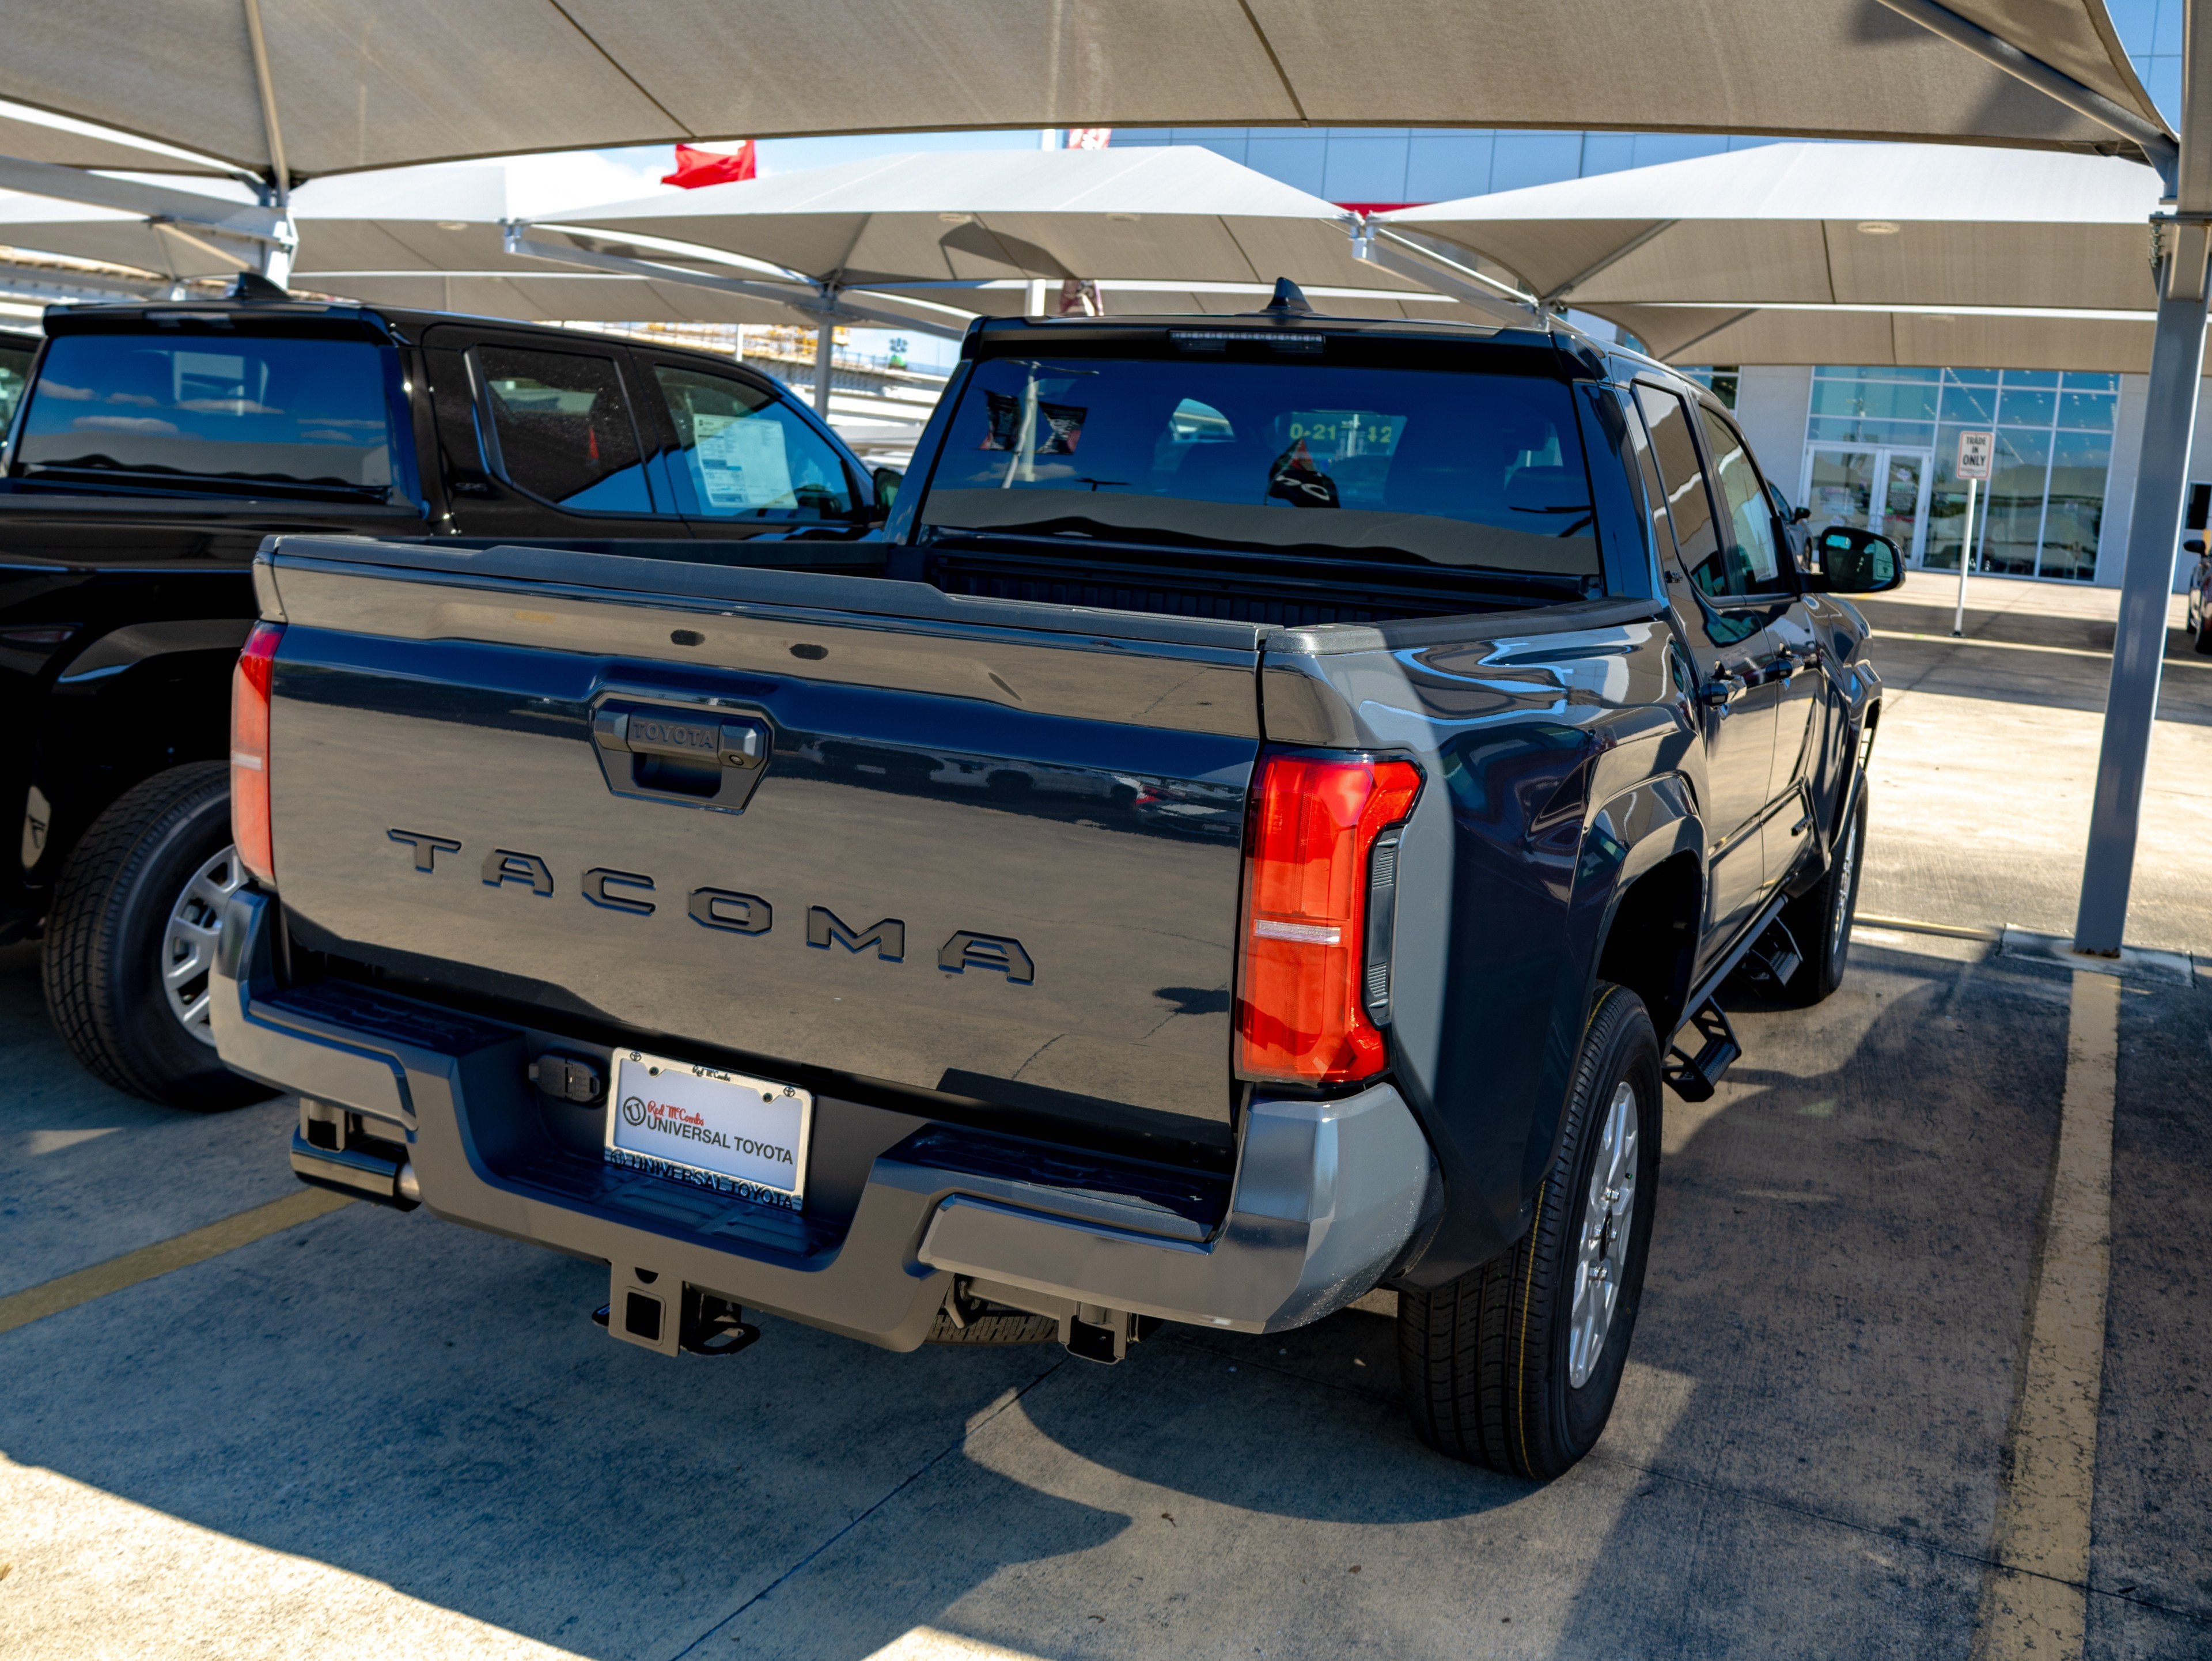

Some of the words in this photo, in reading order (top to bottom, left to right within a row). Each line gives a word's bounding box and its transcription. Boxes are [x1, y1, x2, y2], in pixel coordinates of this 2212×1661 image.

[1966, 437, 1986, 445] TRADE
[1963, 455, 1986, 466] ONLY
[634, 722, 714, 748] TOYOTA
[387, 828, 1035, 986] TACOMA
[692, 1065, 704, 1077] Red
[647, 1100, 665, 1120] Red
[647, 1115, 731, 1149] UNIVERSAL
[734, 1136, 793, 1165] TOYOTA
[632, 1155, 727, 1191] UNIVERSAL
[728, 1177, 793, 1210] TOYOTA
